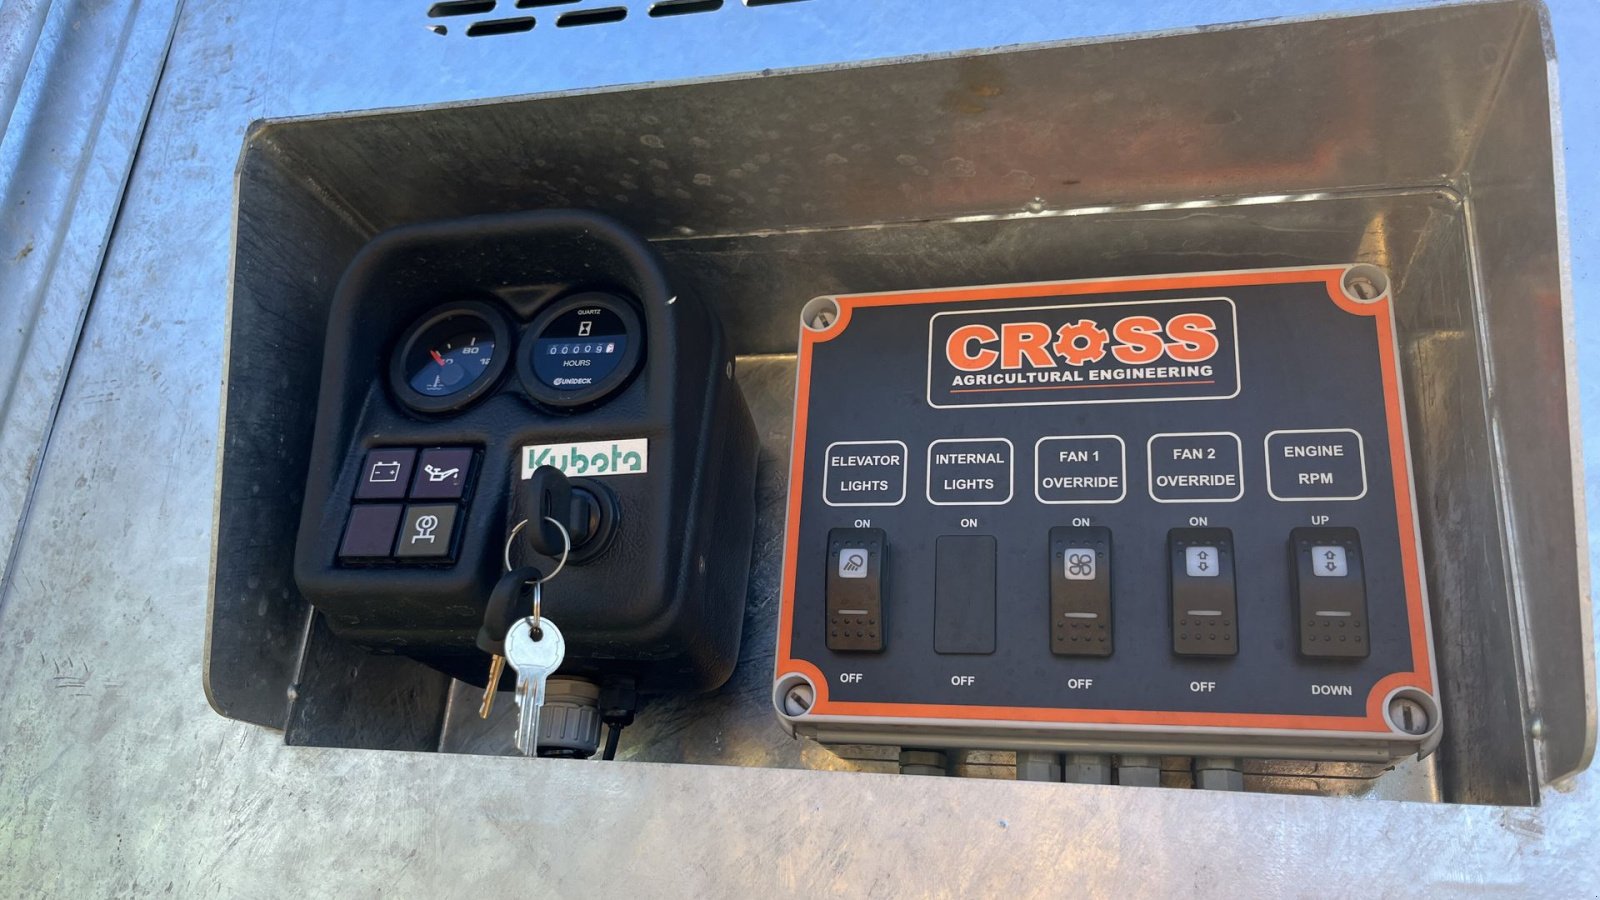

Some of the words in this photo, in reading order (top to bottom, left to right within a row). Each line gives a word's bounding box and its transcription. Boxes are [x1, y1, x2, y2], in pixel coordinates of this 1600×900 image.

[946, 313, 1219, 372] CROSS
[952, 370, 1084, 387] AGRICULTURAL
[1088, 365, 1214, 381] ENGINEERING
[1059, 451, 1087, 462] FAN
[1092, 451, 1100, 461] 1
[1173, 448, 1202, 459] FAN
[1206, 448, 1216, 459] 2
[1284, 445, 1344, 457] ENGINE
[528, 444, 642, 474] Kubota
[831, 455, 900, 467] ELEVATOR
[935, 453, 1005, 465] INTERNAL
[944, 478, 994, 490] LIGHTS
[1042, 476, 1119, 489] OVERRIDE
[1156, 474, 1236, 487] OVERRIDE
[1298, 472, 1334, 485] RPM
[840, 480, 888, 491] LIGHTS
[854, 519, 871, 529] ON
[960, 518, 978, 528] ON
[1072, 517, 1090, 527] ON
[1189, 516, 1208, 527] ON
[1311, 515, 1330, 526] UP
[839, 673, 863, 684] OFF
[951, 675, 975, 686] OFF
[1067, 678, 1093, 690] OFF
[1189, 681, 1216, 693] OFF
[1311, 684, 1353, 696] DOWN
